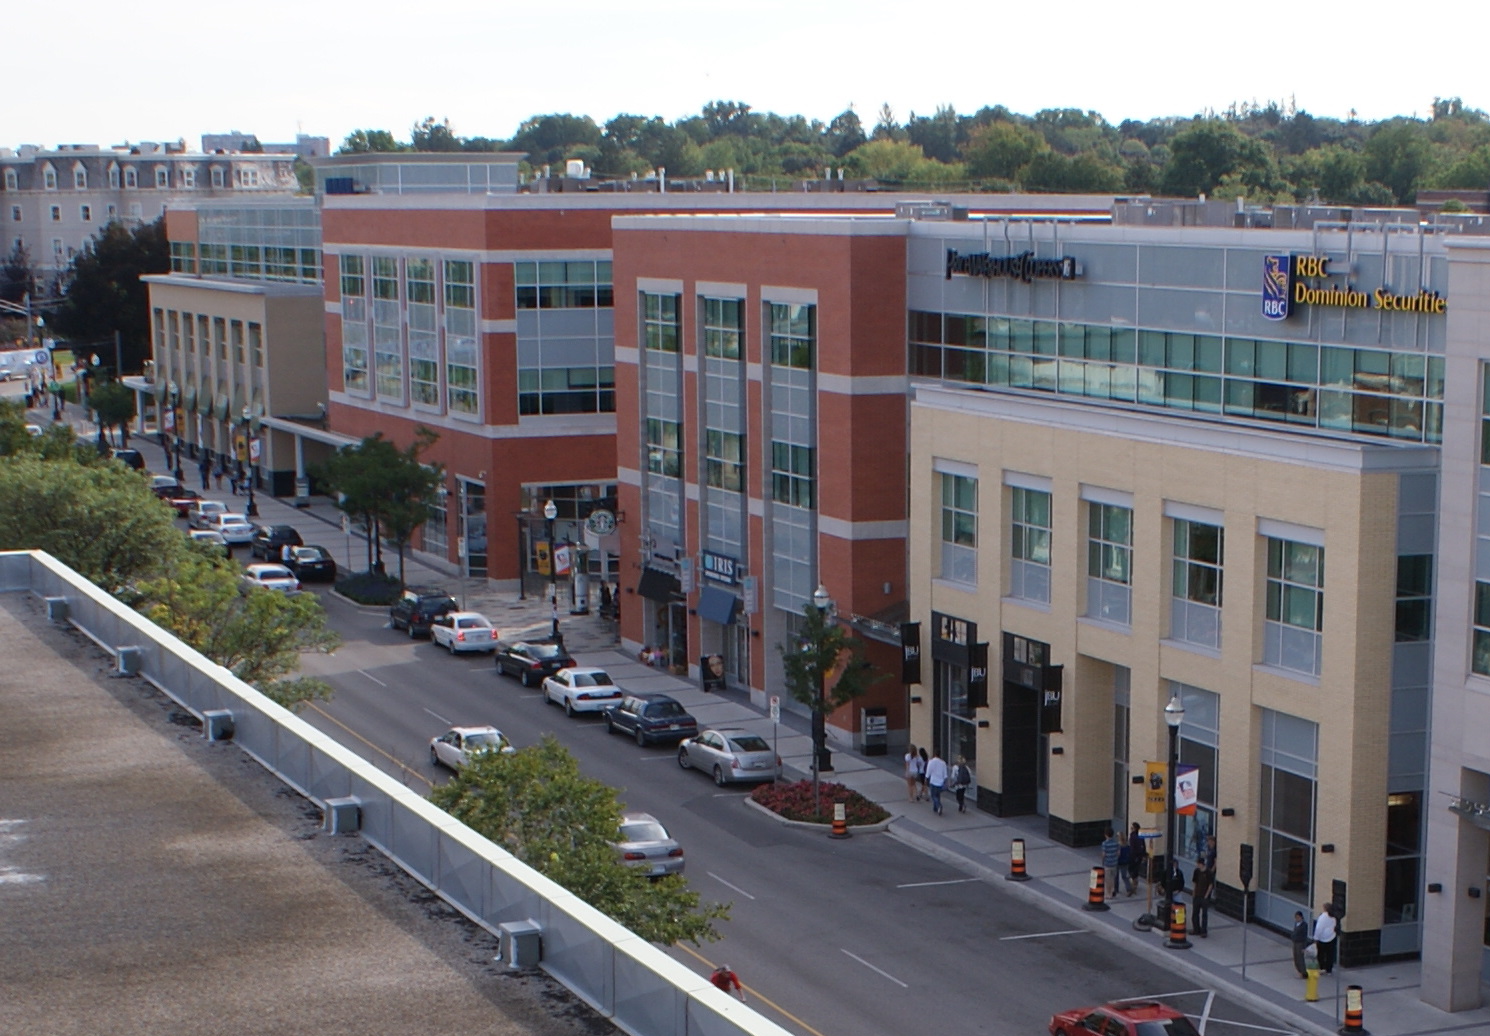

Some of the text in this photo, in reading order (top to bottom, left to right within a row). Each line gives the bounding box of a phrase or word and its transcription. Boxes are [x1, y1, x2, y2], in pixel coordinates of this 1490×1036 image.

[1296, 255, 1332, 278] RBC
[1295, 282, 1368, 309] Dominion
[1264, 301, 1286, 315] RBC
[713, 556, 734, 575] IRIS
